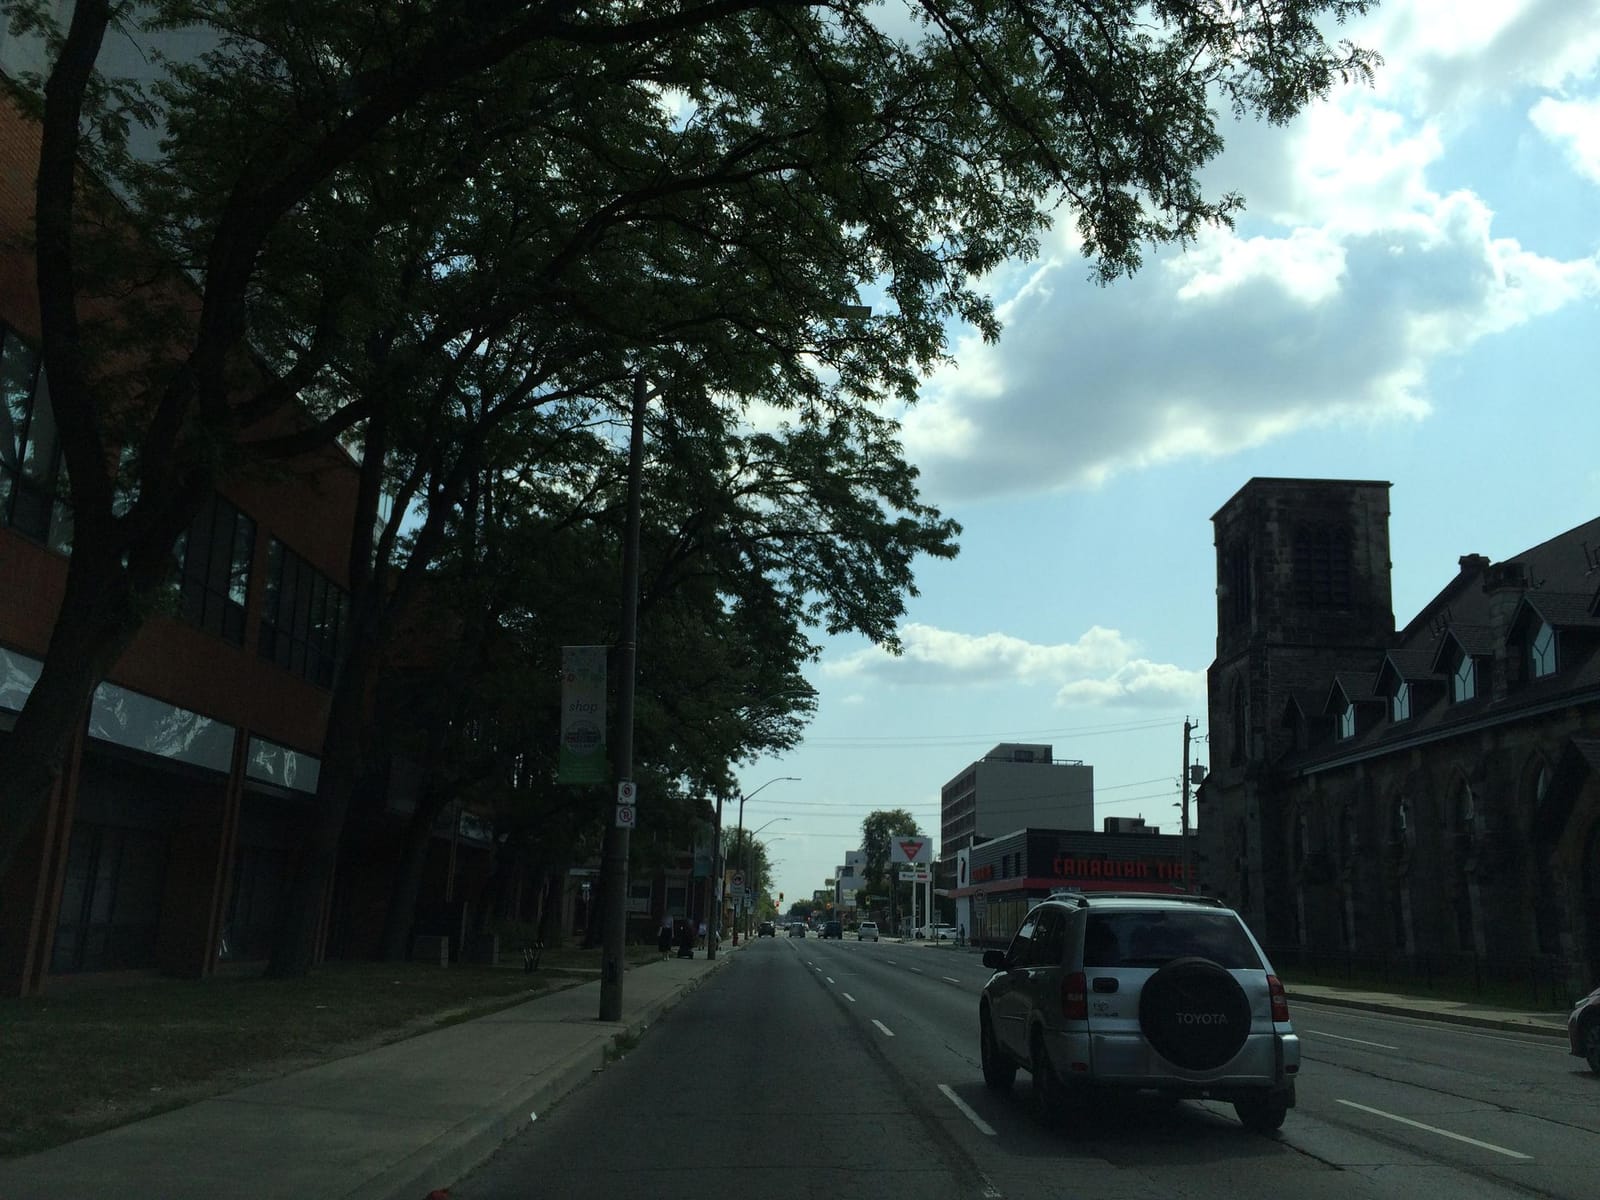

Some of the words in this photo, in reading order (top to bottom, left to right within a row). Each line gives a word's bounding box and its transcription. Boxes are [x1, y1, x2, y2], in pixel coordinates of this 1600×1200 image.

[569, 697, 598, 714] shop
[1053, 857, 1147, 878] CANADIAN
[1175, 1011, 1229, 1025] TOYOTA
